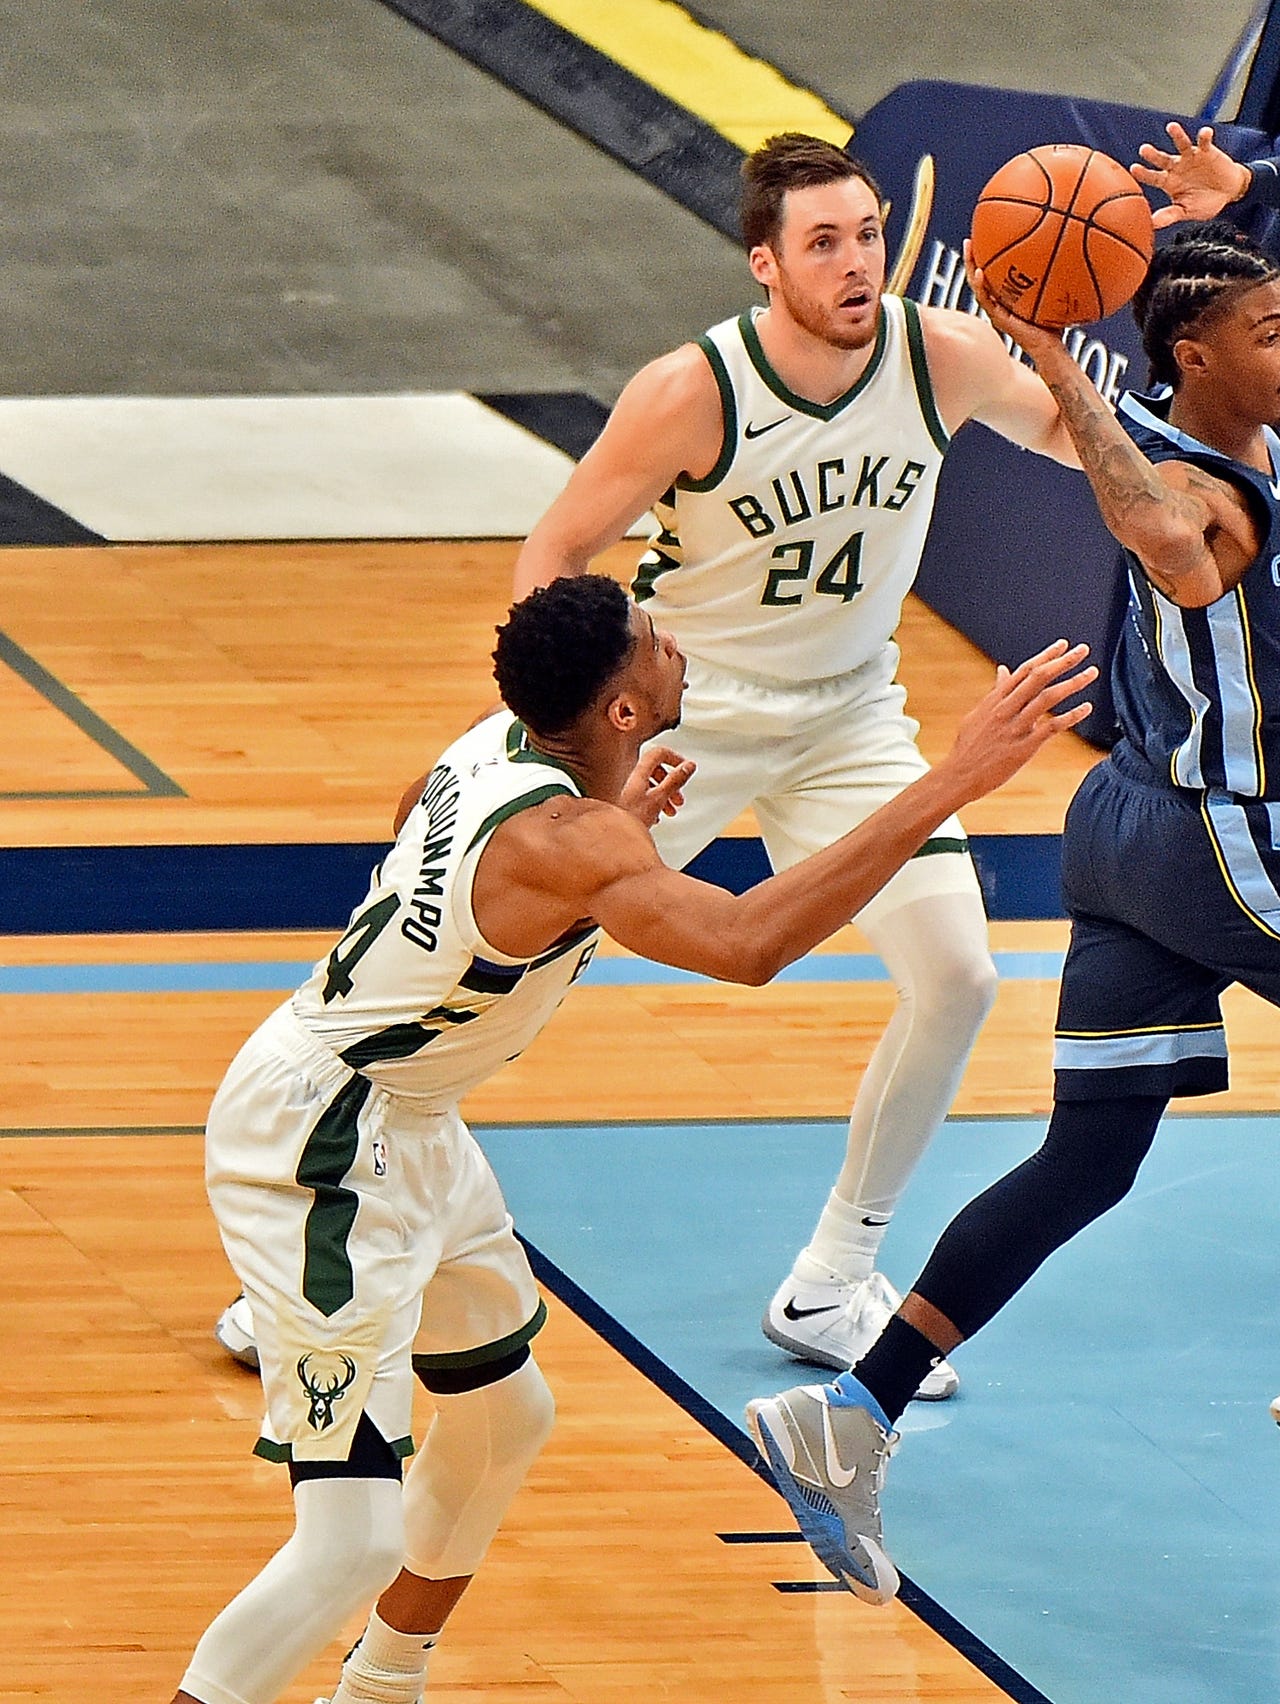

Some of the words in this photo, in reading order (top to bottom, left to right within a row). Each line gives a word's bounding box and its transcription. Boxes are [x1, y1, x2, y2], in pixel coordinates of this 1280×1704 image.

[728, 454, 926, 538] BUCKS
[760, 531, 864, 605] 24
[400, 764, 461, 953] OKOUNMPO
[322, 891, 401, 1005] 4
